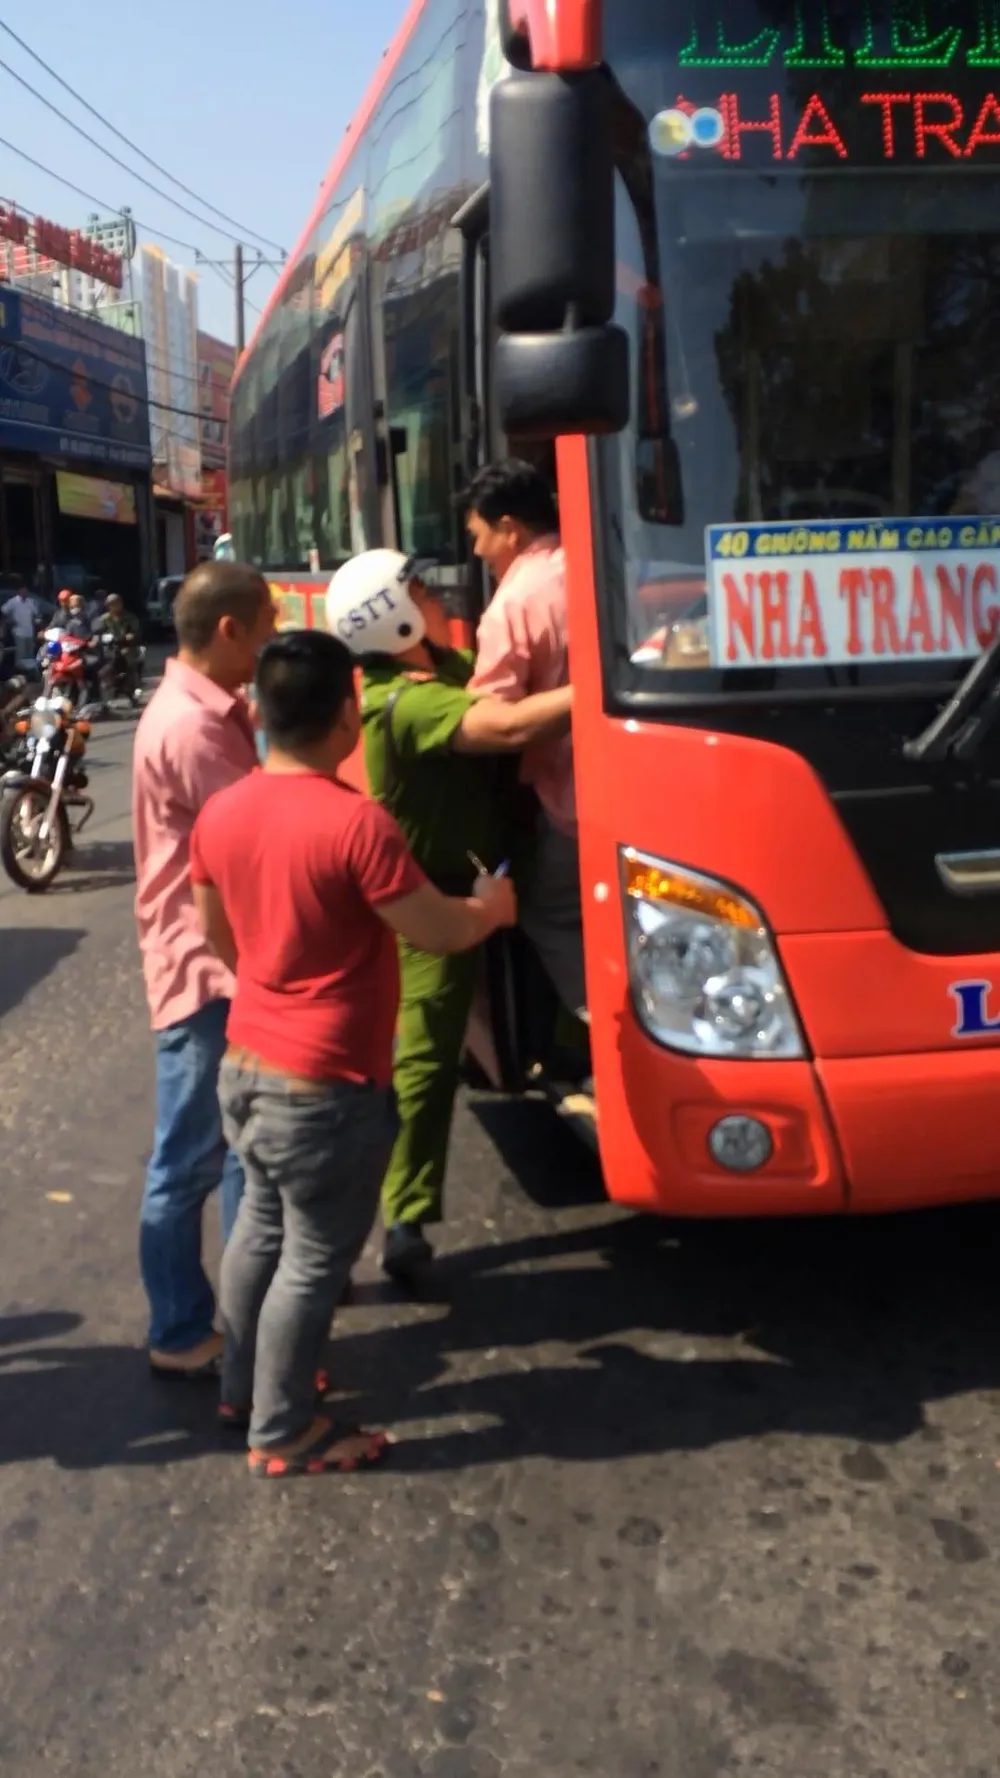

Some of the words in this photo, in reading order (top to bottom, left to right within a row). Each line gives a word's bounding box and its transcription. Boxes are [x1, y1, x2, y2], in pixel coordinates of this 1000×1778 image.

[716, 531, 749, 557] 40
[906, 526, 953, 549] CAO
[337, 588, 396, 640] CSTT
[722, 569, 827, 661] NHA
[838, 561, 1000, 655] TRANG
